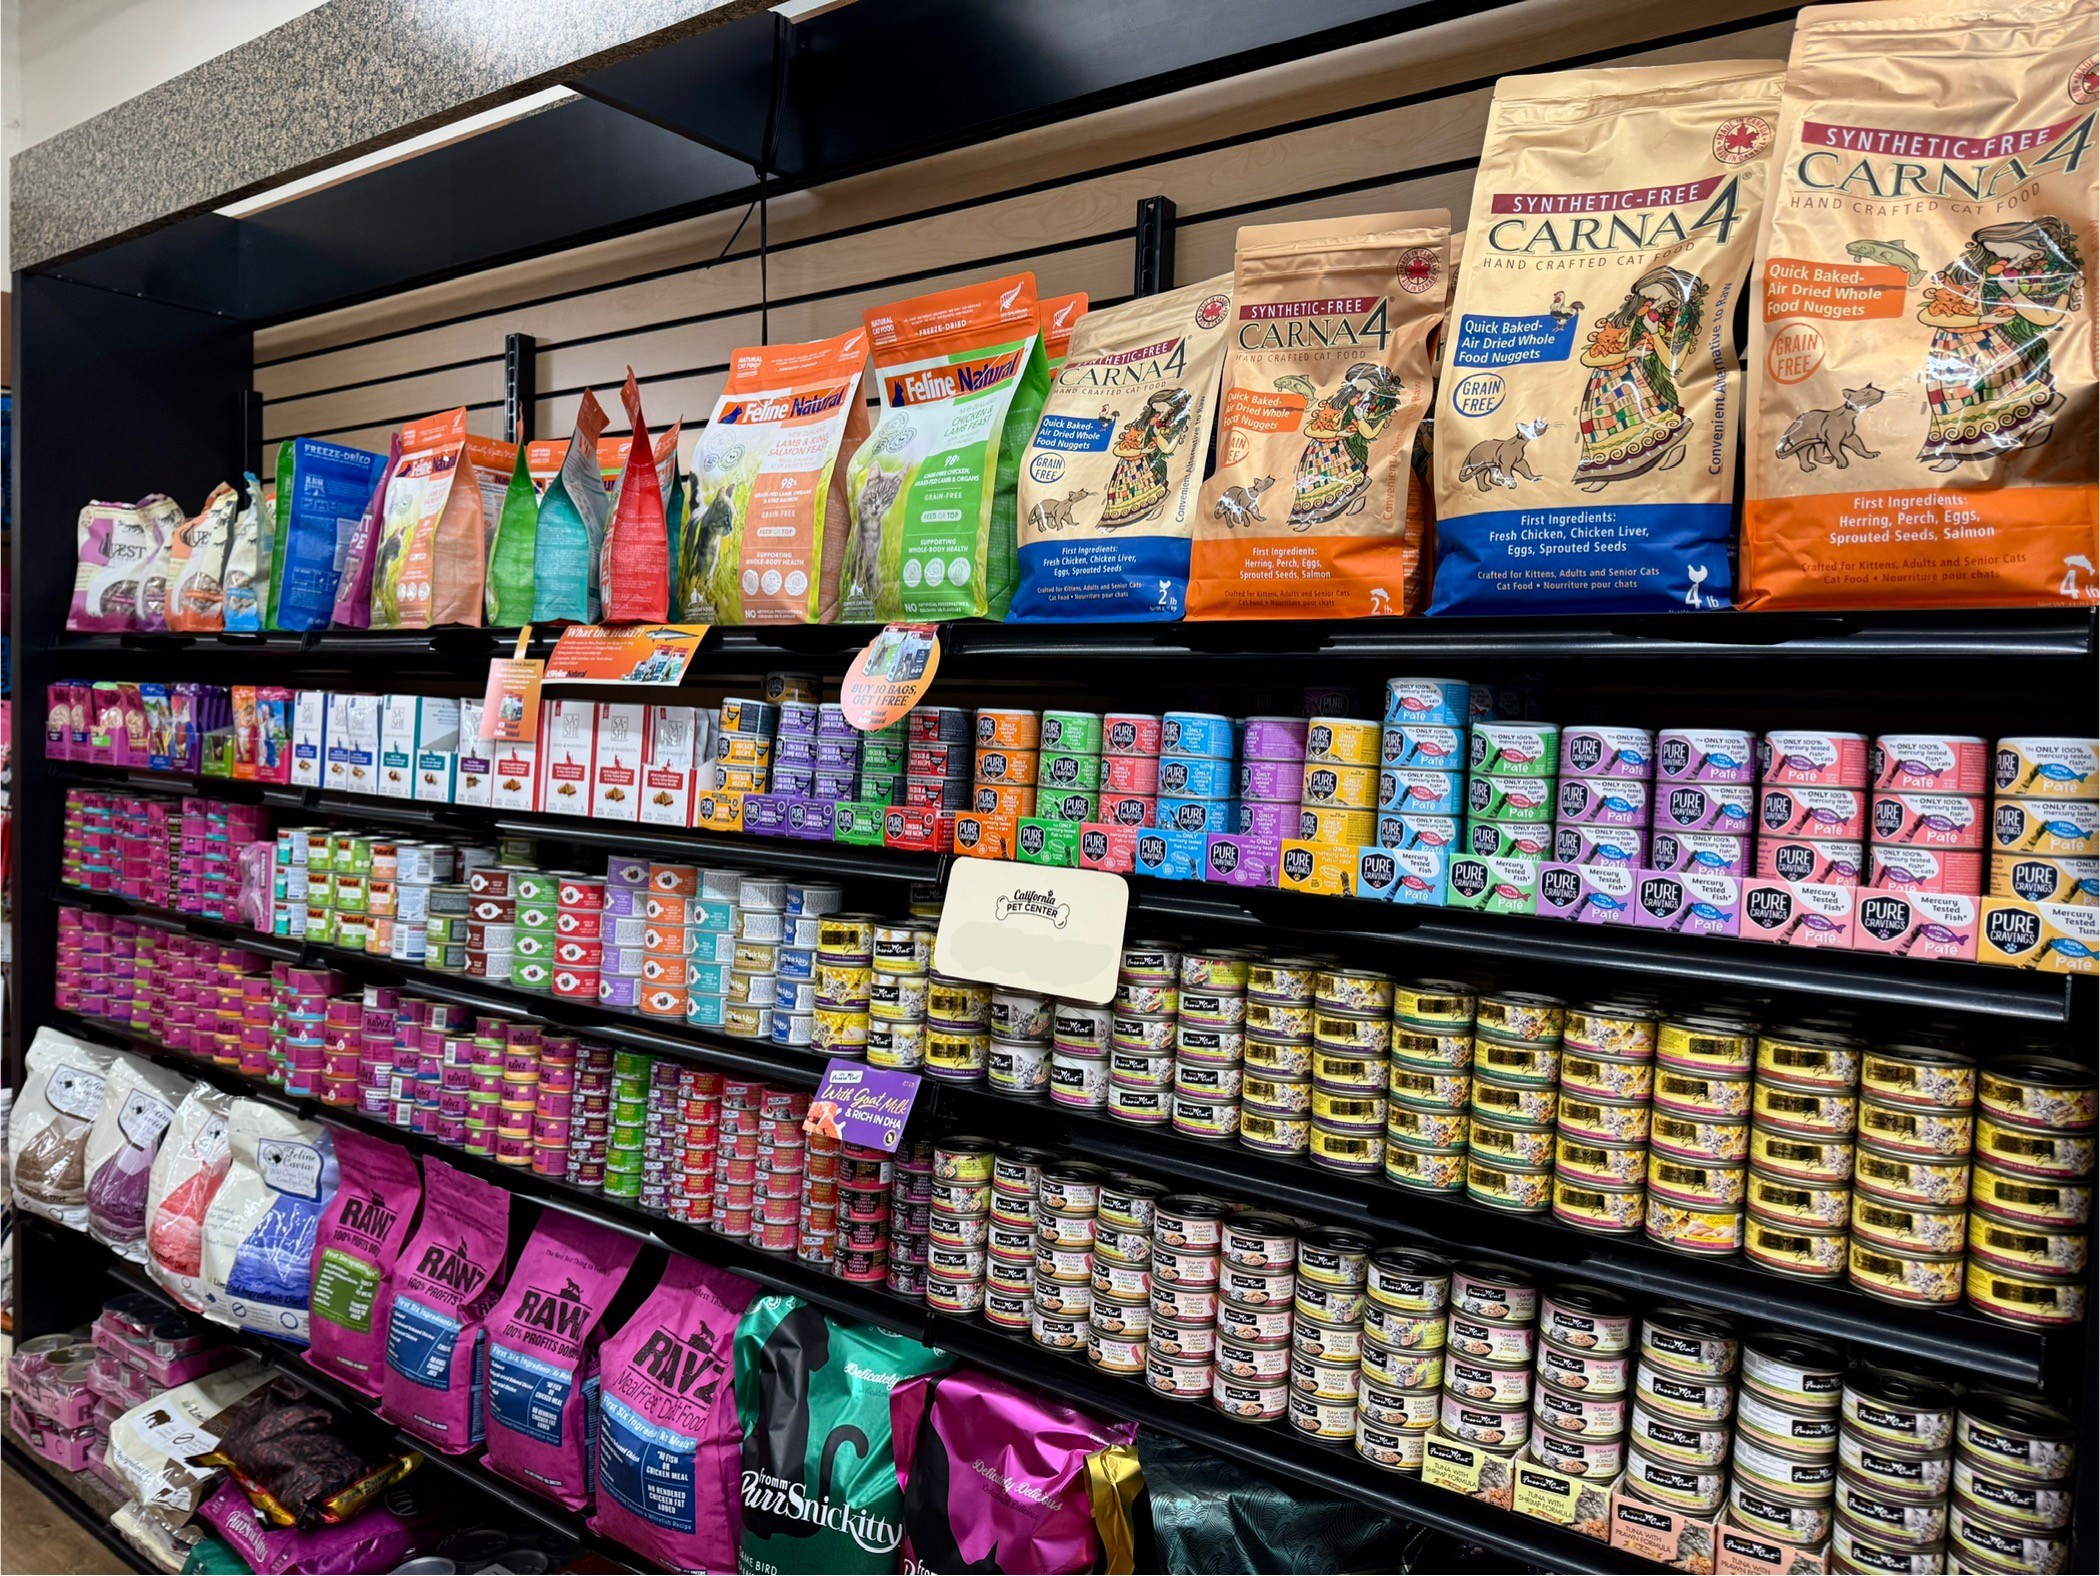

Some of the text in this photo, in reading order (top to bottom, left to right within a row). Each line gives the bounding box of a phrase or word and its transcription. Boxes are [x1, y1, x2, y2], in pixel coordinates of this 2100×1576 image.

[1826, 127, 2050, 159] SYNTHETIC-FREE
[1513, 184, 1700, 212] SYNTHETIC-FREE
[1790, 182, 2040, 217] HAND CRAFTED CAT FOOD
[1483, 242, 1694, 271] HAND CRAFTED CAT FOOD
[1769, 264, 1864, 284] Quick Baked-
[1768, 282, 1882, 300] Air Dried Whole
[1252, 300, 1362, 319] SYNTHETIC-FREE
[1767, 301, 1865, 318] Food Nuggets
[1465, 320, 1543, 335] Quick Baked-
[1462, 334, 1555, 349] Air Dried Whole
[1775, 334, 1817, 355] GRAIN
[1459, 349, 1540, 365] Food Nuggets
[1778, 355, 1811, 377] FREE
[905, 350, 1019, 402] Feline Natural
[1709, 282, 1732, 475] Convenient Alternative to Raw
[1462, 380, 1501, 396] GRAIN
[742, 387, 845, 423] Feline Natural
[1463, 397, 1493, 412] FREE
[924, 492, 962, 500] GRAIN-FREE
[1854, 494, 1968, 510] First Ingredients:
[1521, 512, 1616, 528] First Ingredients:
[1840, 510, 1980, 529] Herring, Perch, Eggs,
[1490, 525, 1650, 542] Fresh Chicken, Chicken Liver,
[1830, 526, 1995, 547] Sprouted Seeds, Salmon
[1508, 541, 1627, 558] Eggs, Sprouted Seeds
[1478, 566, 1660, 580] Crafted for Kittens, Adults and Senior Cats
[1497, 579, 1637, 591] Cat Food Nourriture pour chats
[2060, 570, 2079, 599] 4
[1685, 584, 1719, 609] 4 lb
[567, 628, 645, 638] What the Hoki?!
[852, 684, 916, 695] BUY 10 BAGS,
[853, 696, 873, 704] GET
[882, 696, 909, 706] FREE
[959, 823, 980, 834] PURE
[1212, 846, 1239, 858] PURE
[1402, 853, 1428, 862] Mercury
[1364, 858, 1392, 872] PURE
[1418, 866, 1432, 874] Fish
[1364, 870, 1392, 880] CRAVINGS
[1014, 889, 1056, 905] California
[1921, 896, 1958, 907] Mercury
[1007, 903, 1058, 918] PET CENTER
[1866, 902, 1905, 920] PURE
[1933, 905, 1960, 913] Tested
[2052, 909, 2093, 920] Mercury
[1865, 918, 1905, 931] CRAVINGS
[1991, 912, 2035, 933] PURE
[2065, 917, 2095, 927] Tested
[1990, 930, 2035, 945] CRAVINGS
[821, 1084, 909, 1114] With Goat Milk
[845, 1108, 901, 1129] & RICH IN DHA
[408, 1277, 458, 1306] 100% PROFITS
[844, 1362, 899, 1390] Delicately
[1425, 1466, 1477, 1488] SHRIMP FORMULA
[1434, 1462, 1469, 1478] TUNA WITH
[758, 1468, 788, 1489] fromm
[1014, 1482, 1063, 1511] Delicious
[1615, 1529, 1672, 1554] PRAWN FORMULA
[1625, 1526, 1662, 1542] TUNA WITH
[756, 1560, 777, 1575] BIRD
